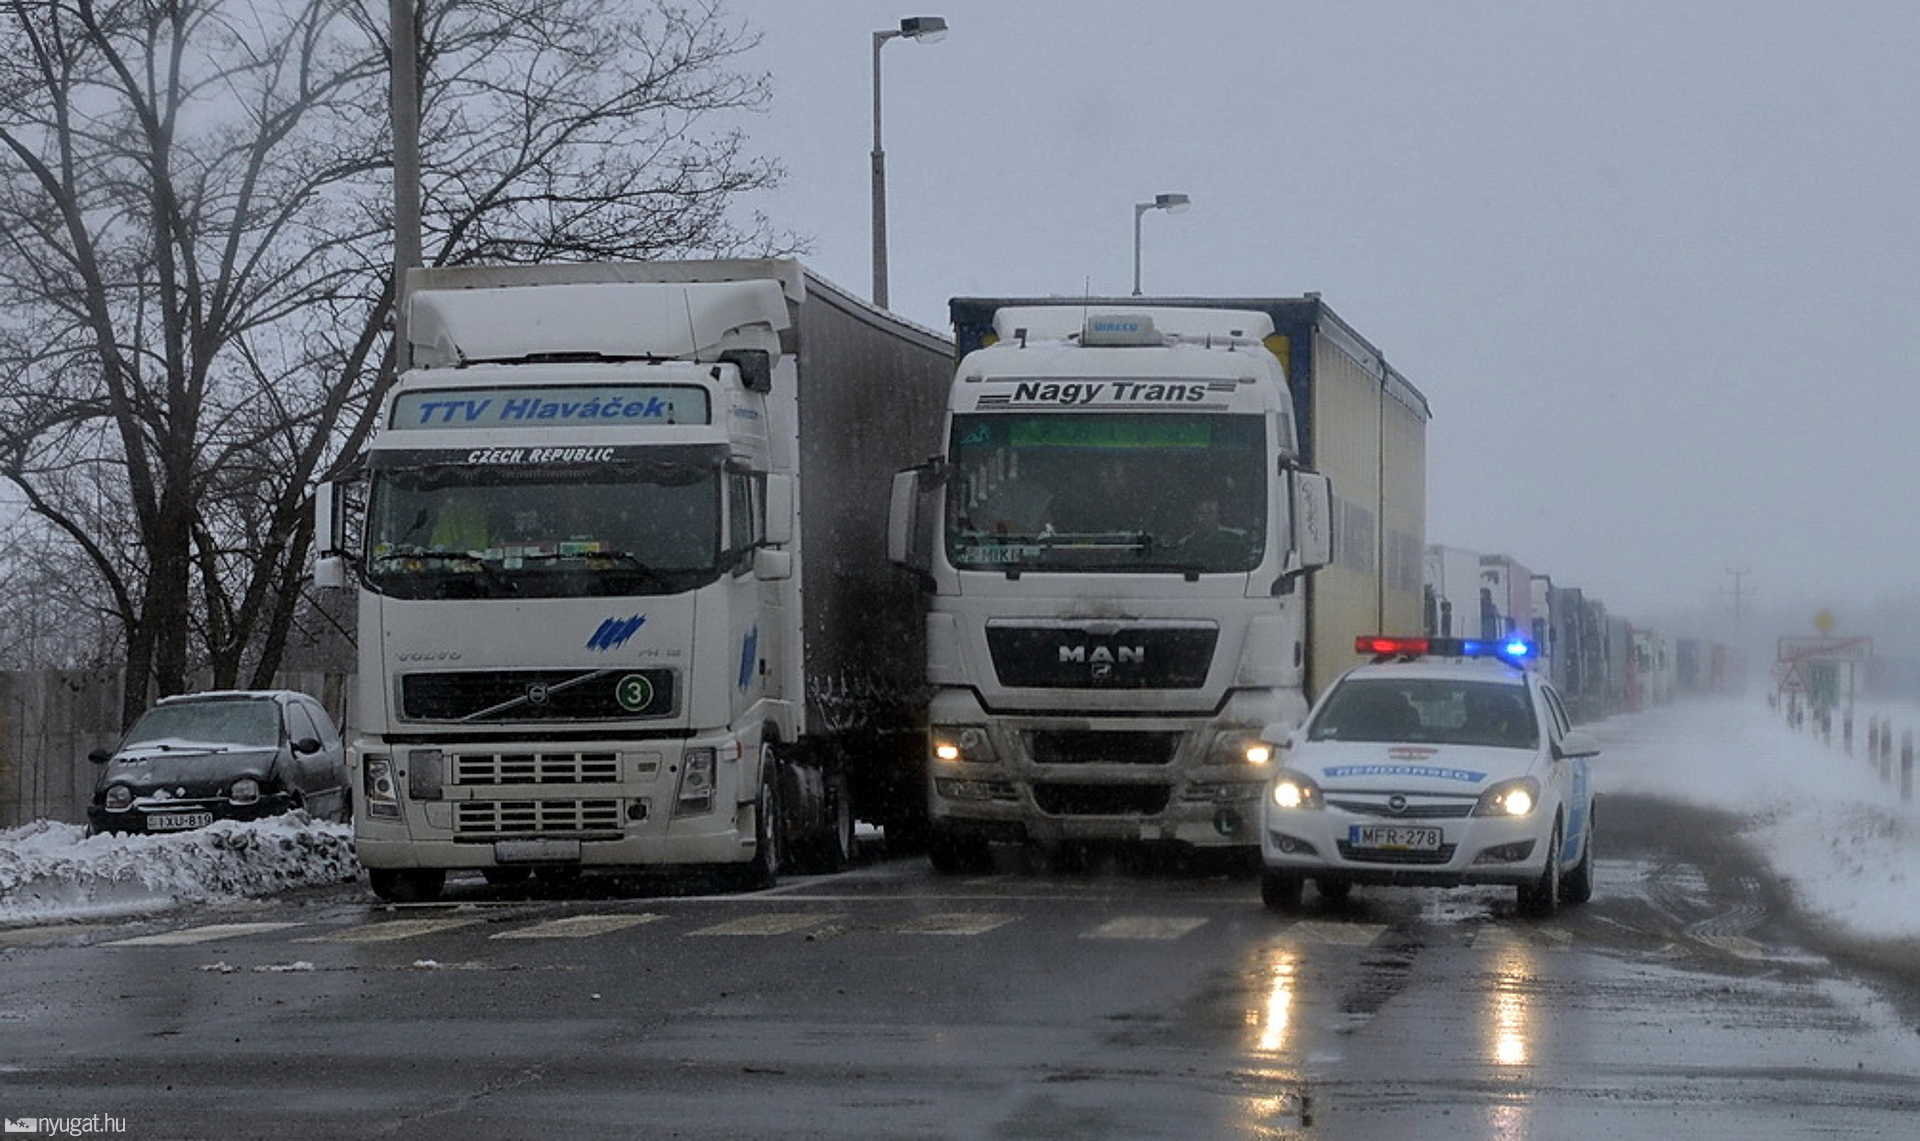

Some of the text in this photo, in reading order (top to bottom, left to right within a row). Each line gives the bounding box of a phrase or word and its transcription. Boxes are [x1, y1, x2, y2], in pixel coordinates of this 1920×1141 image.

[1013, 381, 1206, 404] Nagy Trans
[419, 396, 666, 425] TTV Hlaváček
[468, 448, 615, 464] CZECH REPUBLIC
[1058, 645, 1145, 663] MAN
[627, 682, 643, 704] 3
[1362, 828, 1438, 846] MFR-278
